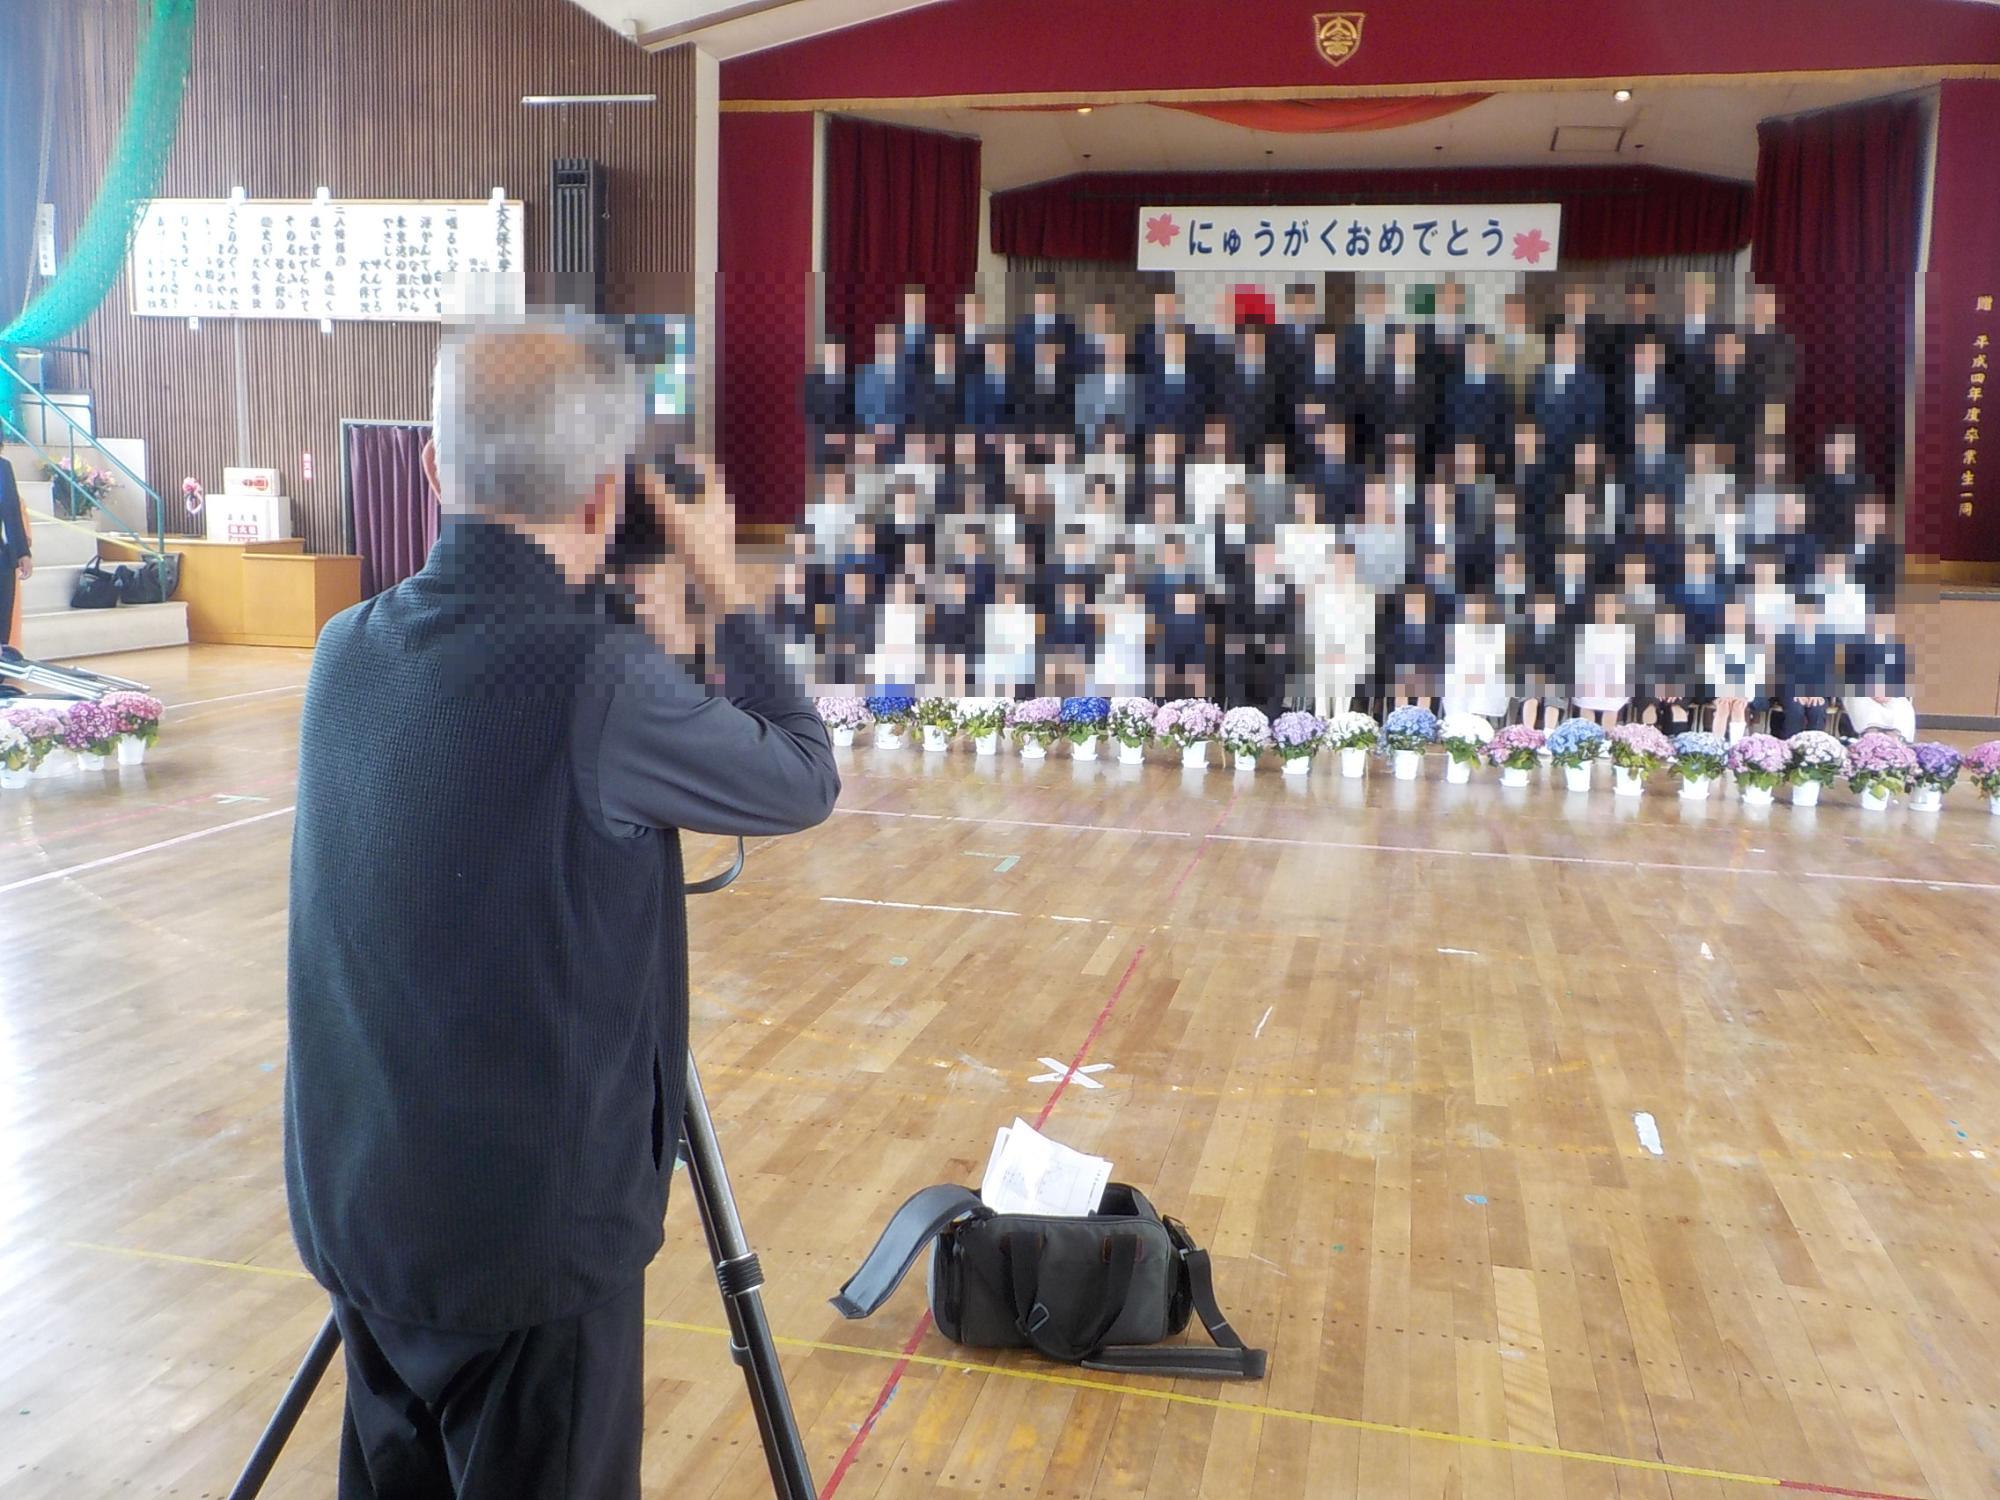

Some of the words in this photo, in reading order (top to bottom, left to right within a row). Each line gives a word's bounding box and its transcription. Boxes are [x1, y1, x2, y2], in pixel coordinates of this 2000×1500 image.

[1189, 218, 1504, 257] にゅうがくおめでとう
